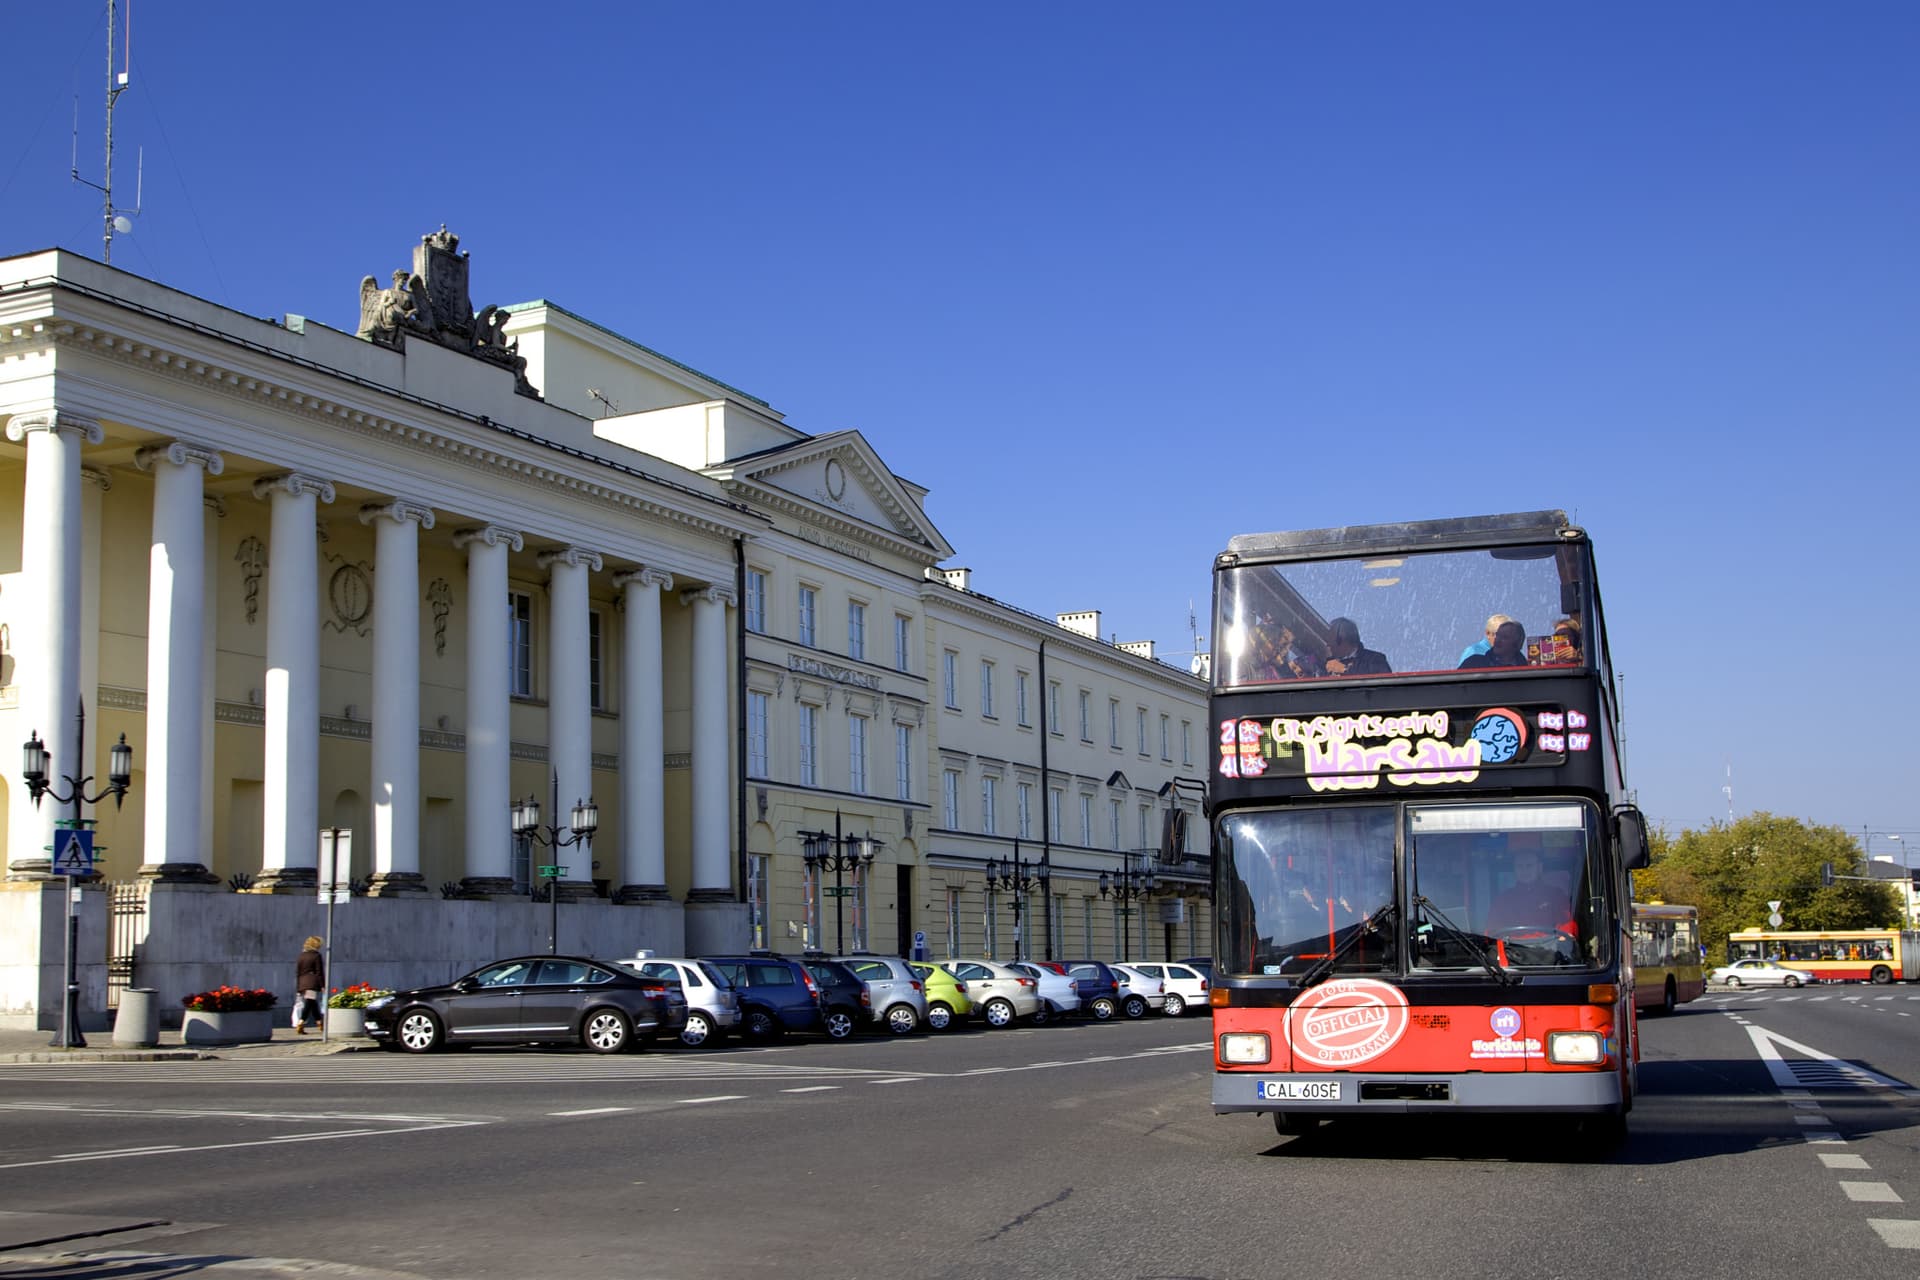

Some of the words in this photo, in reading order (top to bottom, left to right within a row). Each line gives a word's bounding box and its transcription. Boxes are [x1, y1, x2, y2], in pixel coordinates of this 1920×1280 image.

[1538, 712, 1563, 731] Hop
[1567, 710, 1588, 728] On
[1538, 734, 1564, 752] Hop
[1568, 733, 1591, 751] Off
[1317, 984, 1357, 999] TOUR
[1308, 1006, 1382, 1036] OFFICIAL
[1318, 1049, 1336, 1060] OF
[1339, 1030, 1391, 1060] WARSAW
[1267, 1083, 1297, 1098] CAL
